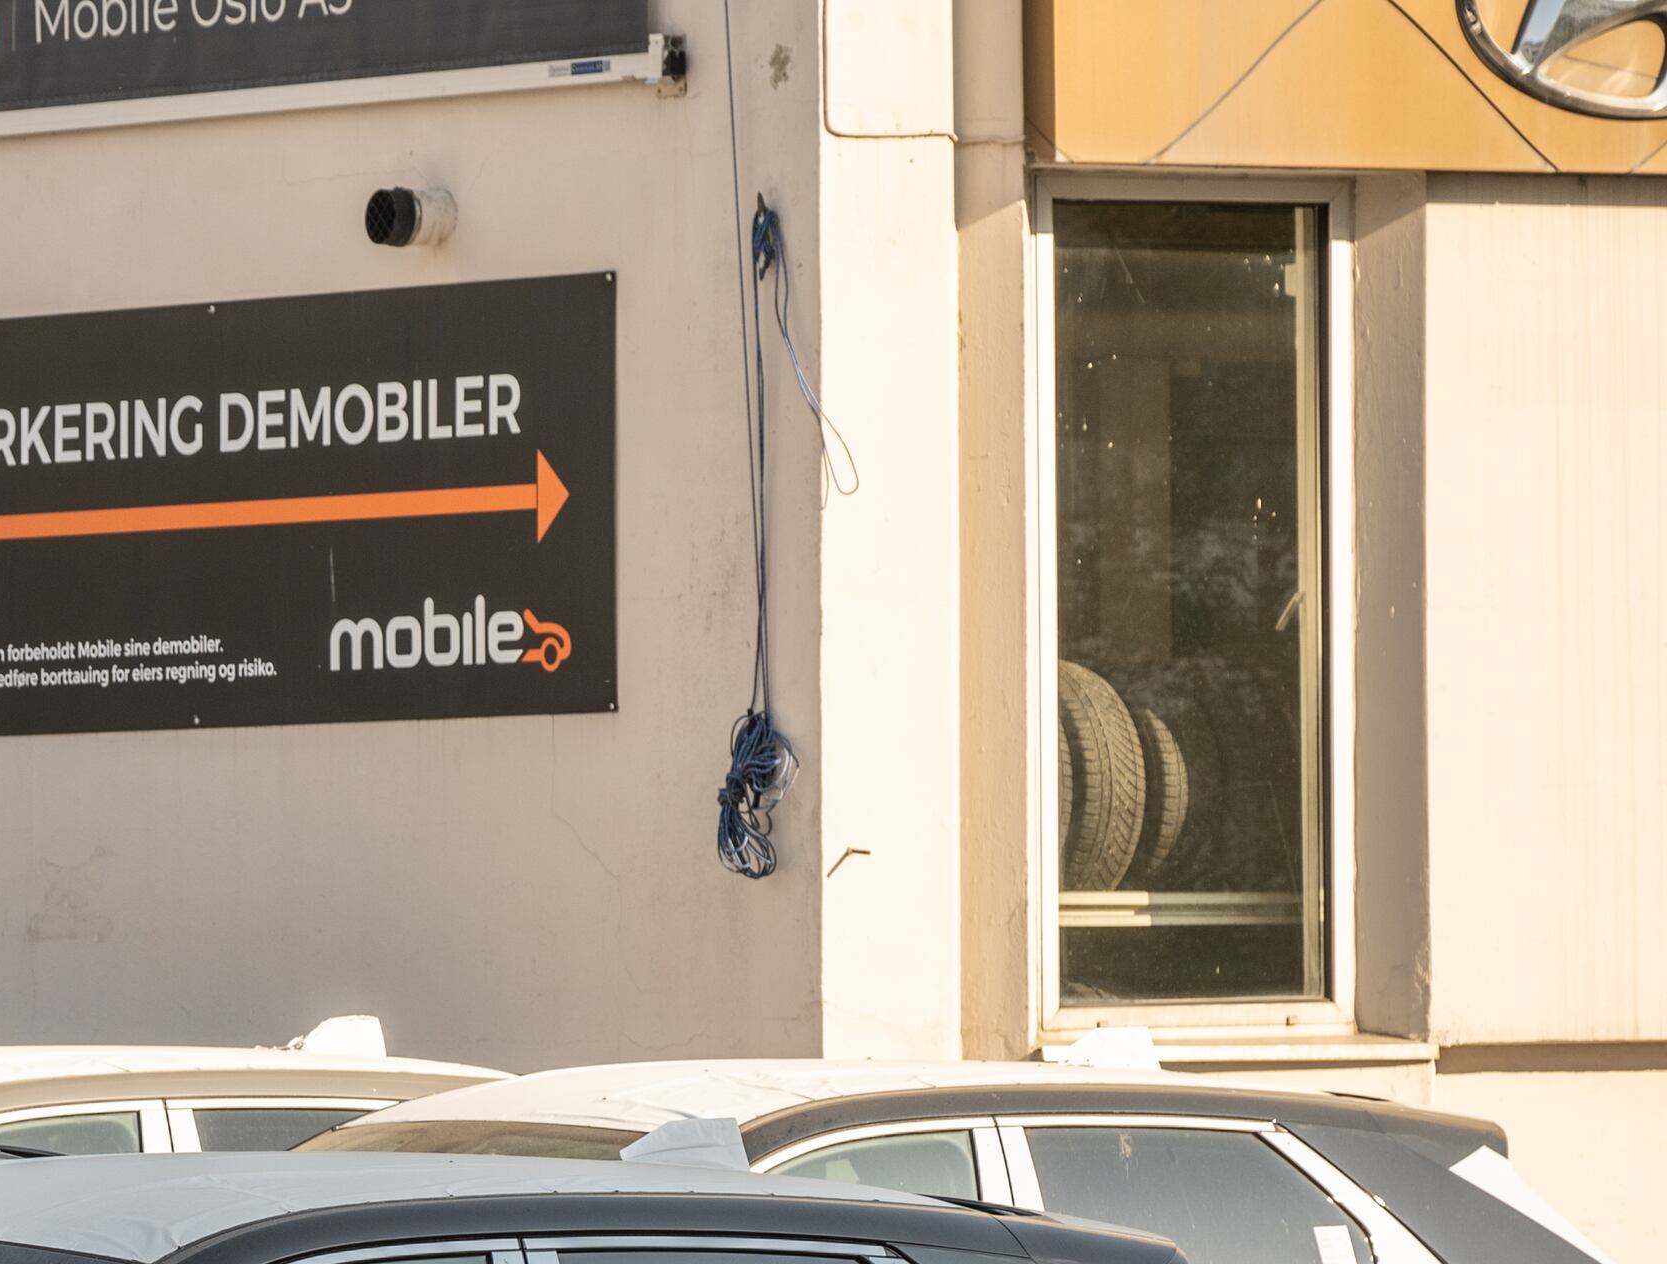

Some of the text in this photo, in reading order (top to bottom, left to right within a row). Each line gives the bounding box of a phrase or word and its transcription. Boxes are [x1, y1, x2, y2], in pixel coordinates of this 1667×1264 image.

[219, 373, 521, 453] DEMOBILER
[7, 641, 76, 662] forbeholdt
[78, 639, 122, 659] Mobile
[123, 637, 151, 657] sine
[153, 634, 224, 656] demobiler.
[329, 594, 524, 671] mobile
[40, 665, 109, 687] borttauing
[111, 664, 130, 683] for
[132, 663, 163, 682] eiers
[165, 660, 216, 684] regning
[218, 663, 236, 682] og
[238, 657, 277, 677] risiko.
